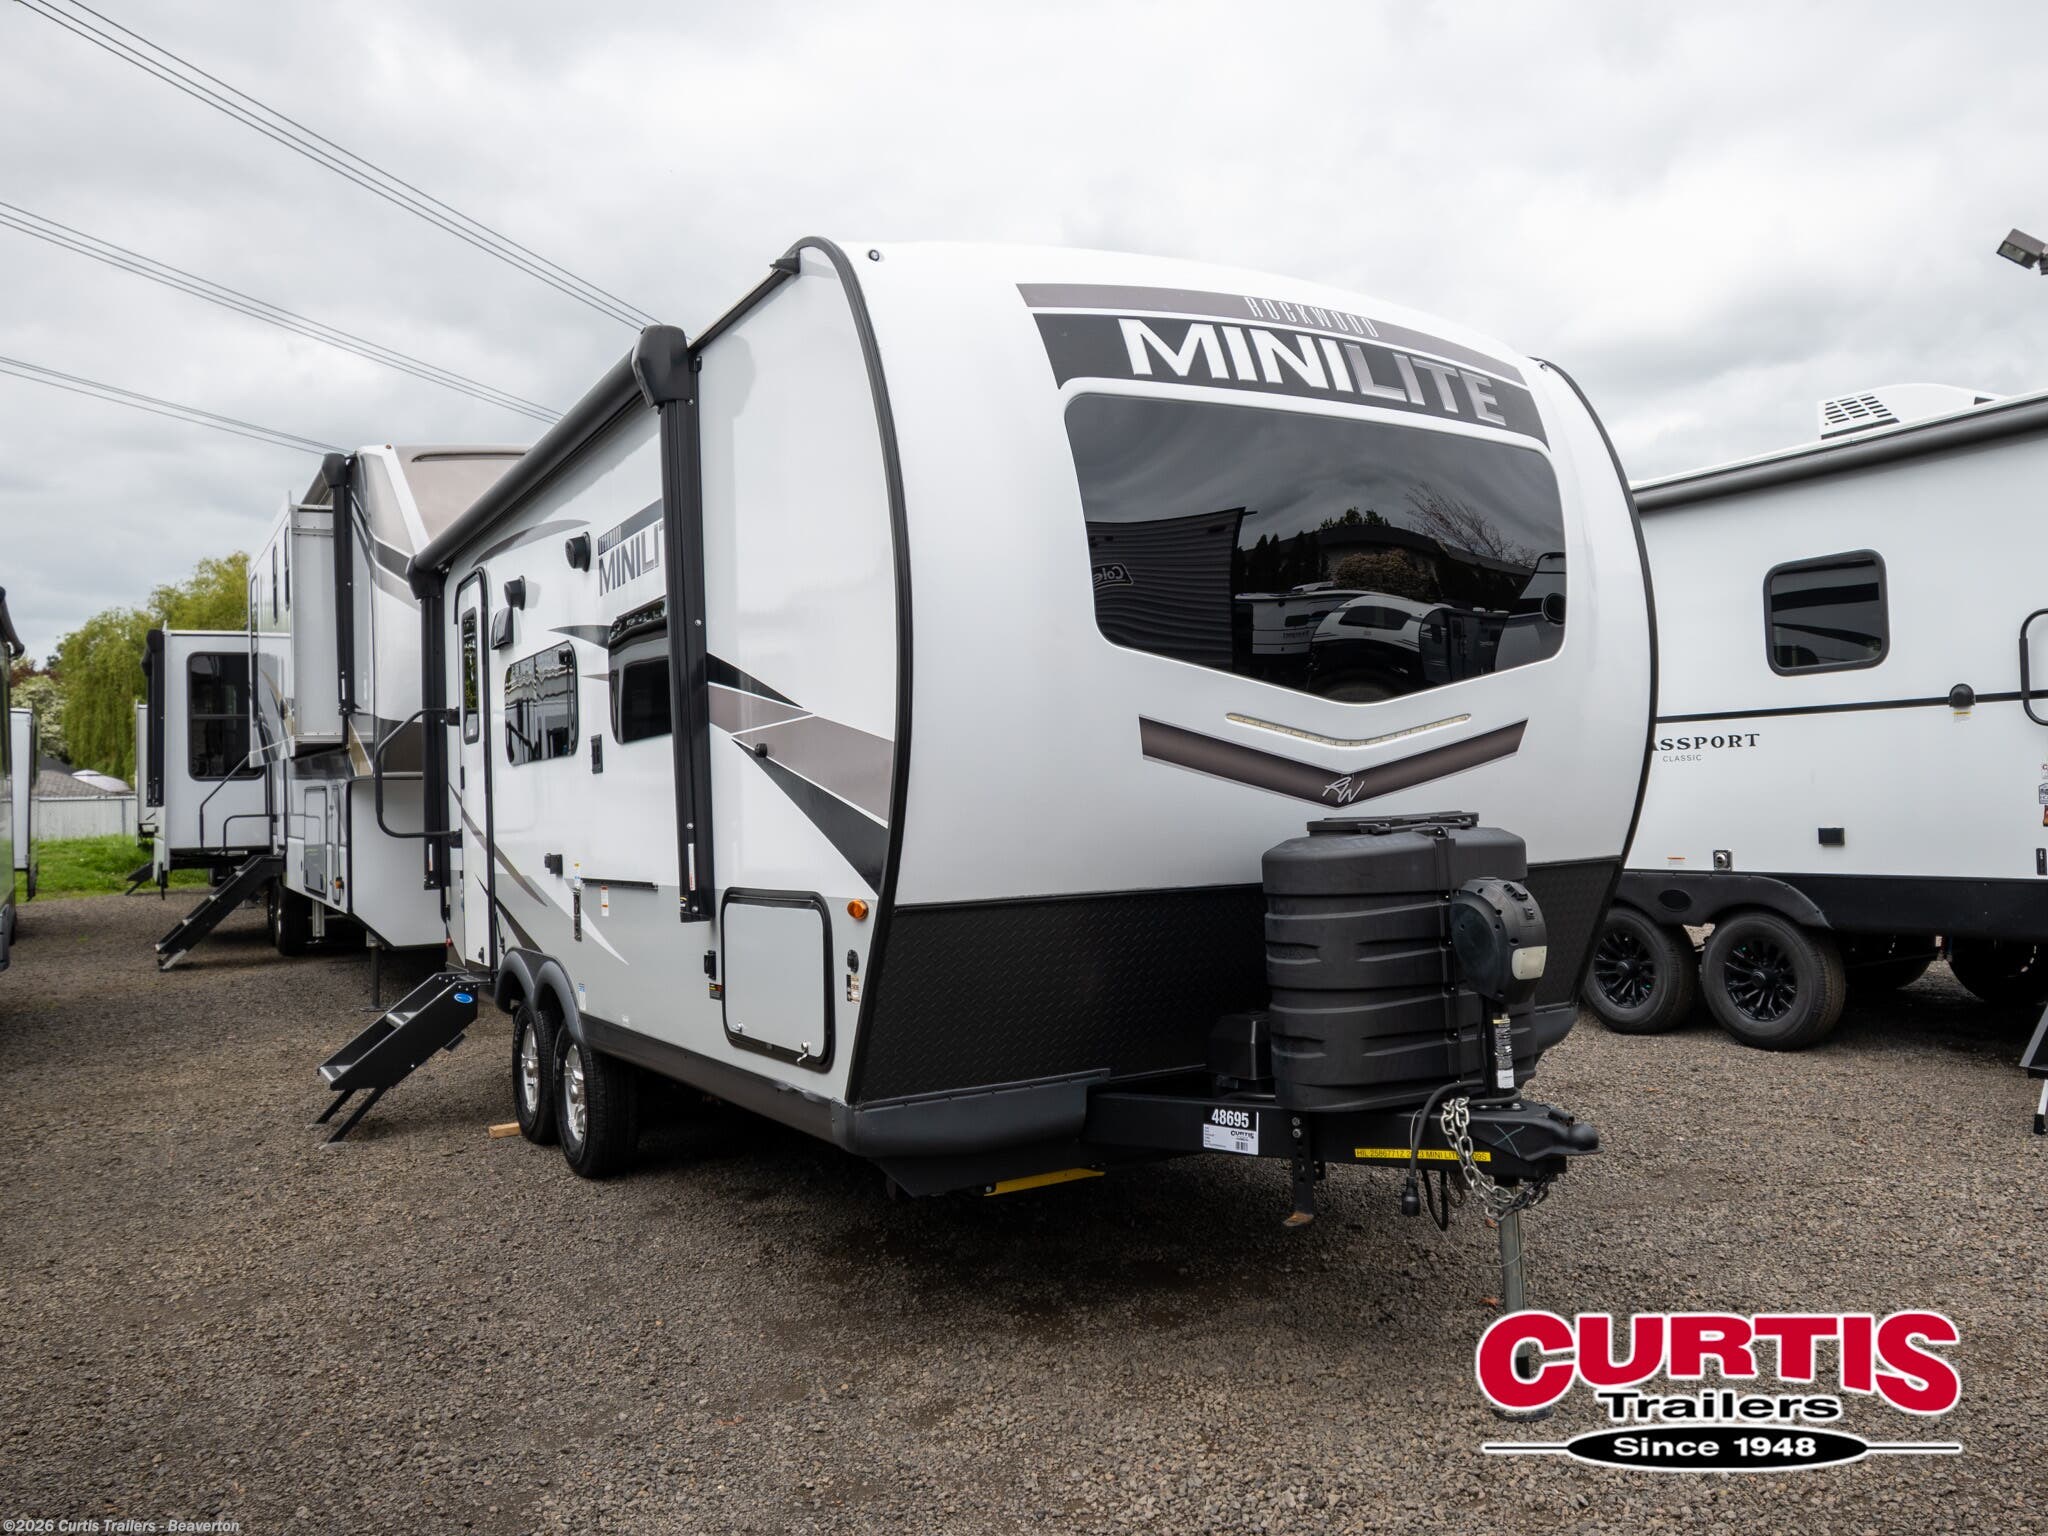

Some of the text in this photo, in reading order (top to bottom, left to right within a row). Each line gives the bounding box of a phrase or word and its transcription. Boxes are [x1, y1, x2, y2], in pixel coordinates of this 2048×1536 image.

[1243, 296, 1380, 338] ROCKWOOD
[1662, 754, 1703, 763] CLASSIC
[1211, 1108, 1250, 1128] 48695
